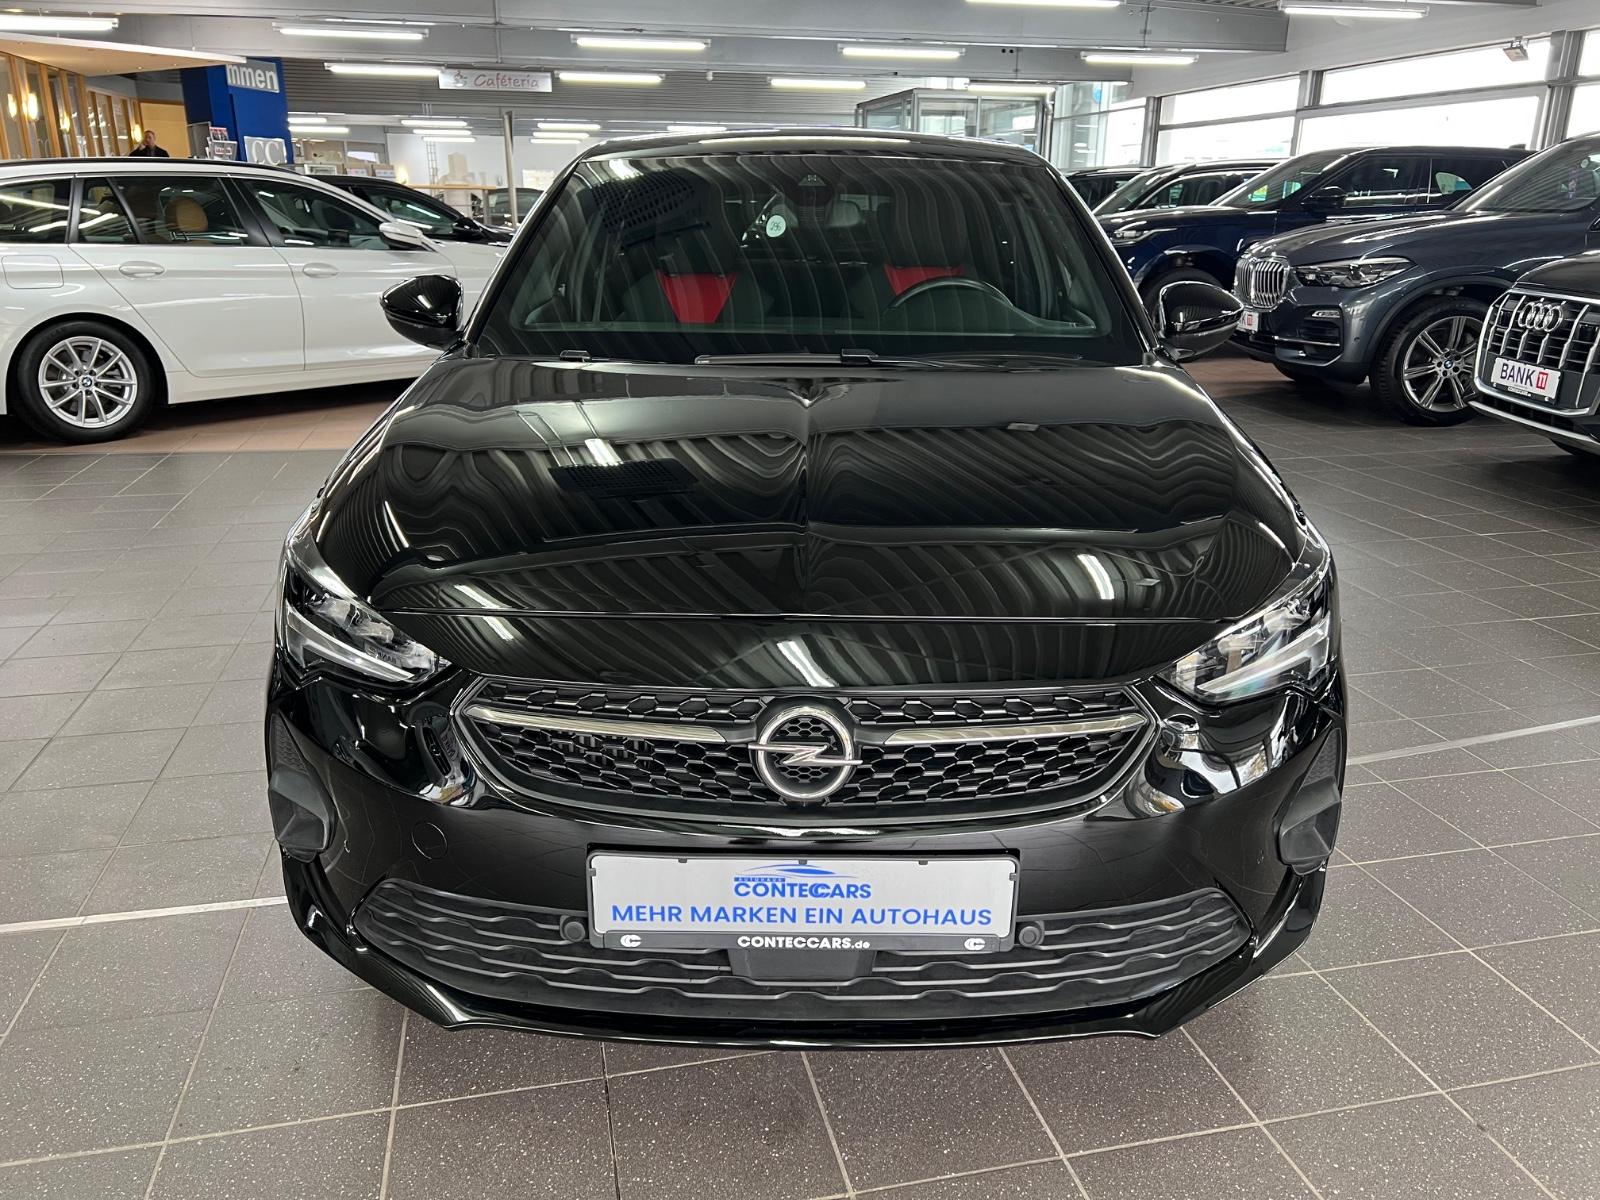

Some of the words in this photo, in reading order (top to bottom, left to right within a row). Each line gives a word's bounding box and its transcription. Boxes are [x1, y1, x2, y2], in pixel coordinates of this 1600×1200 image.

[1500, 363, 1535, 387] BANK
[612, 905, 682, 922] MEHR
[691, 906, 797, 924] MARKEN
[805, 907, 843, 924] EIN
[851, 908, 992, 926] AUTOHAUS
[737, 935, 871, 950] CONTECCARS.de
